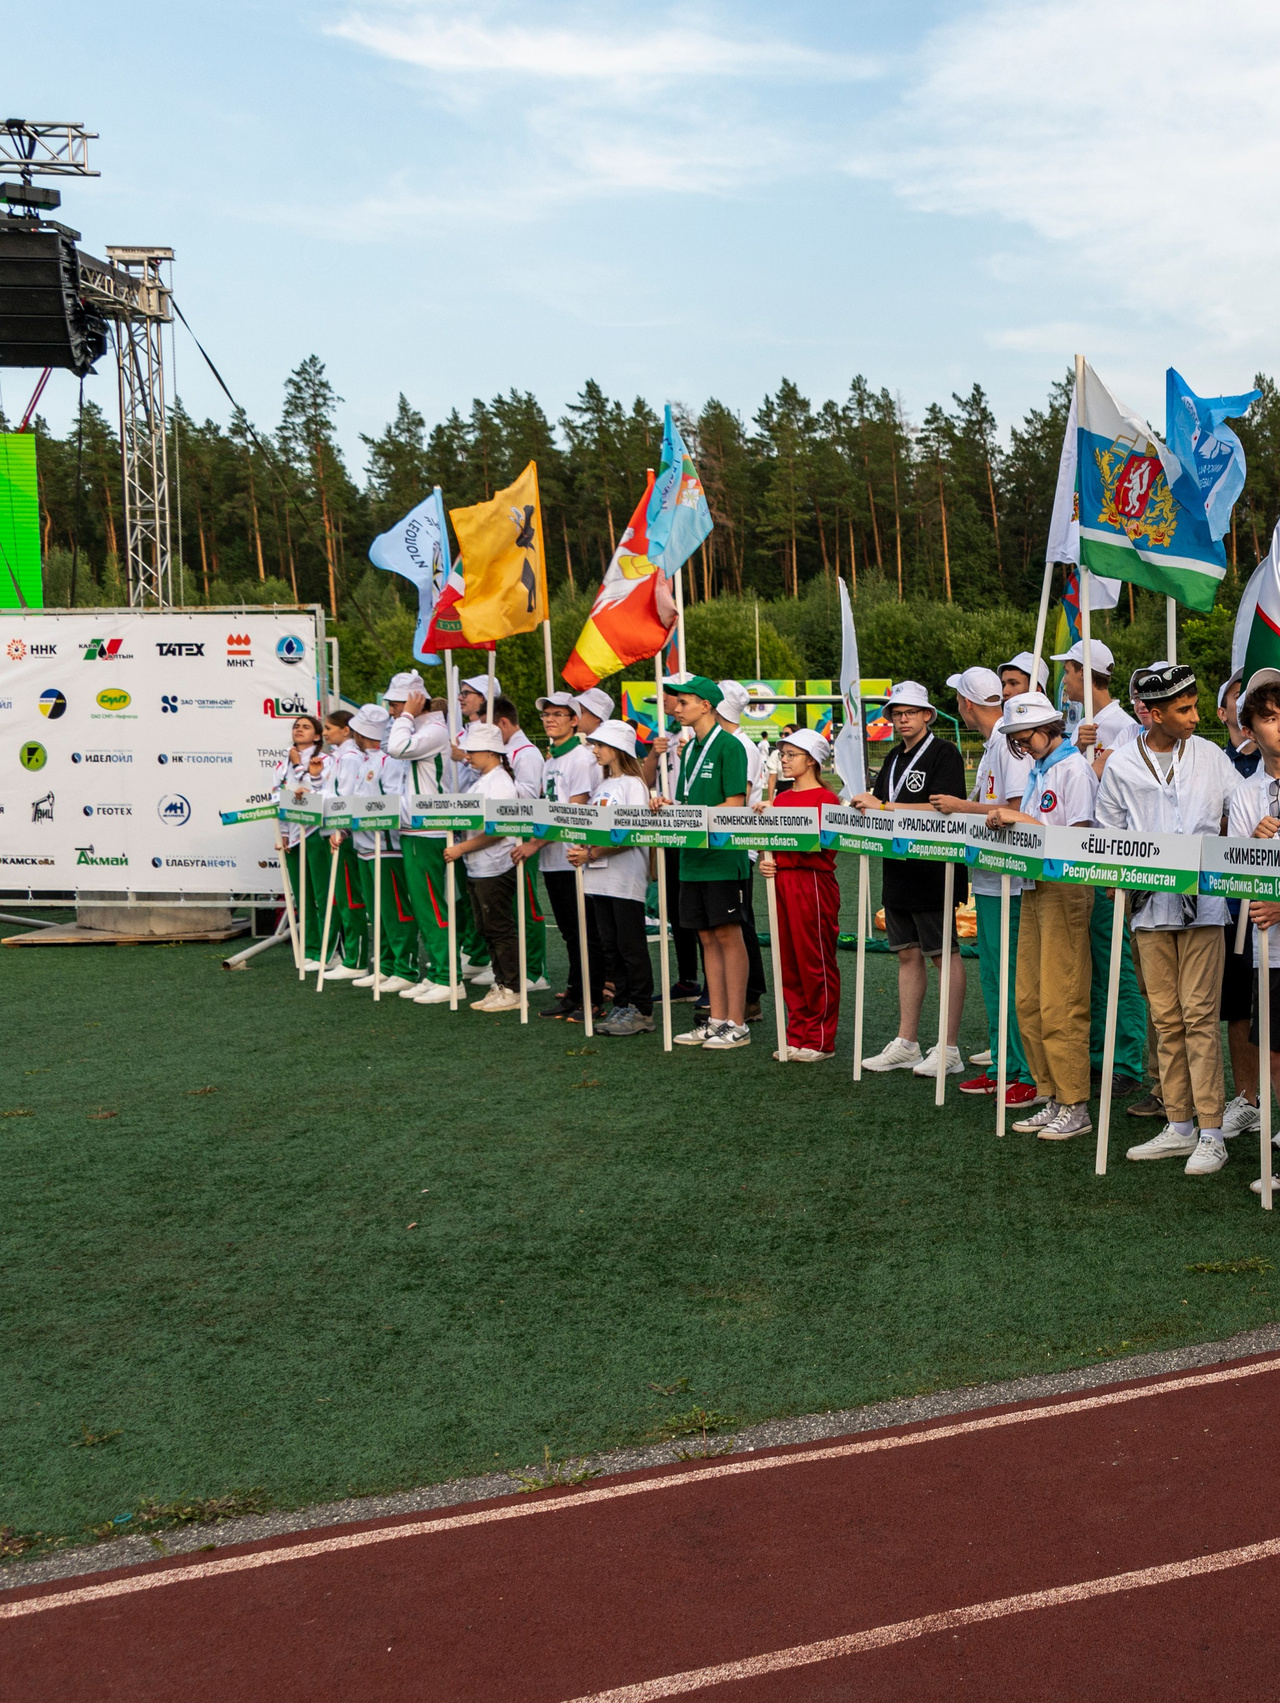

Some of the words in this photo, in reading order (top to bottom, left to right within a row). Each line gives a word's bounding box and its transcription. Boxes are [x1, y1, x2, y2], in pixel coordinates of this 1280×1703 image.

[30, 644, 57, 655] ННК
[227, 659, 255, 667] МНКТ
[85, 753, 133, 763] ИДЕЛОЙЛ
[97, 807, 133, 816] ГЕОТЕХ
[614, 808, 640, 818] «КОМАНДА
[658, 809, 675, 818] ЮНЫХ
[675, 809, 703, 818] ГЕОЛОГОВ
[614, 818, 631, 827] ИМЕНИ
[632, 819, 662, 829] АКАДЕМИКА
[673, 820, 703, 829] ОБРУЧЕВА»
[713, 815, 758, 826] «ТЮМЕНСКИЕ
[758, 816, 779, 826] ЮНЫЕ
[780, 816, 813, 827] ГЕОЛОГИ»
[825, 811, 849, 826] «ШКОЛА
[850, 814, 871, 829] ЮНОГО
[898, 817, 946, 833] «УРАЛЬСКИЕ
[636, 832, 688, 846] Санкт-Петербург
[730, 834, 770, 846] Тюменская
[770, 835, 799, 846] область
[839, 834, 861, 849] Томская
[861, 839, 884, 852] область
[1007, 830, 1042, 849] ПЕРЕВАЛ»
[1081, 833, 1161, 858] «ЁШ-ГЕОЛОГ»
[907, 841, 957, 856] Свердловская
[978, 850, 1005, 868] Самарская
[1005, 856, 1027, 872] область
[1062, 862, 1118, 882] Республика
[1120, 867, 1177, 887] Узбекистан
[1208, 874, 1252, 896] Республика
[1253, 880, 1273, 895] Саха
